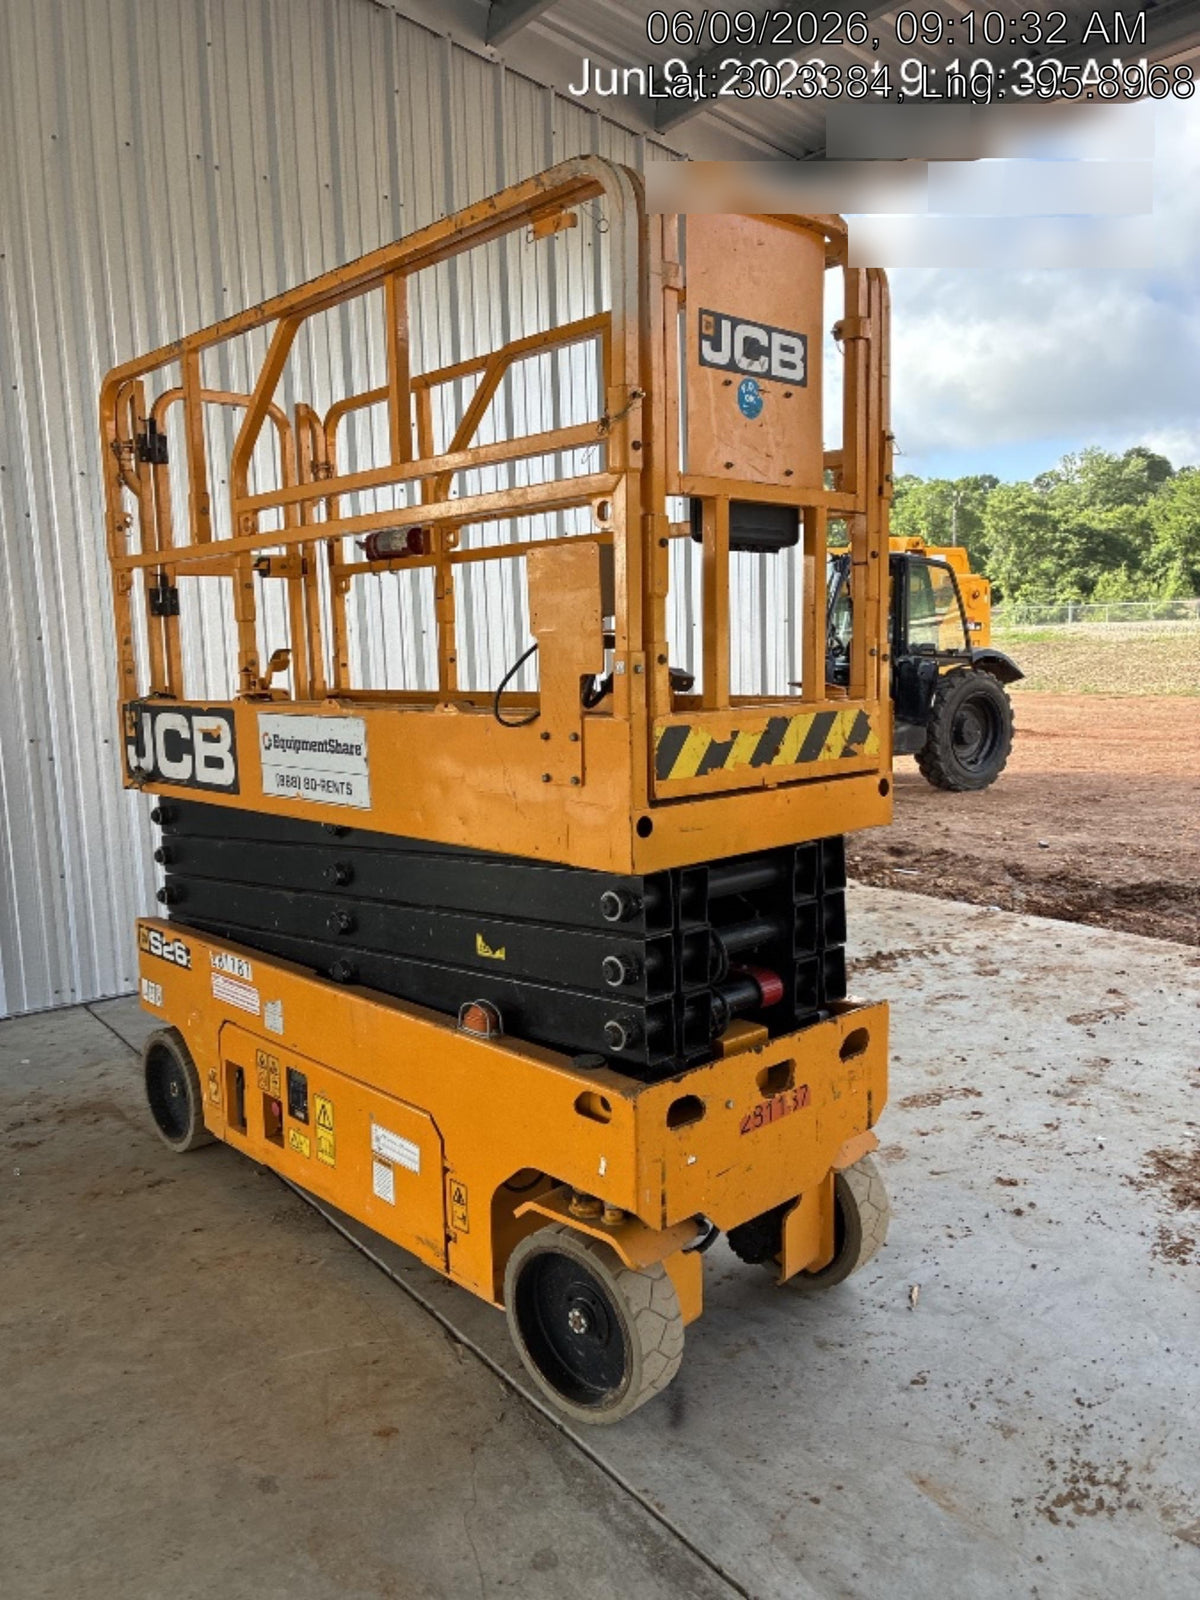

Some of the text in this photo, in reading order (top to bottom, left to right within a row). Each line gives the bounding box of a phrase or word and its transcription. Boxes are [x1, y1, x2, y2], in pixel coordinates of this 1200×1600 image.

[702, 319, 804, 381] JCB
[127, 711, 235, 787] JCB
[273, 734, 362, 756] EquipmentShare
